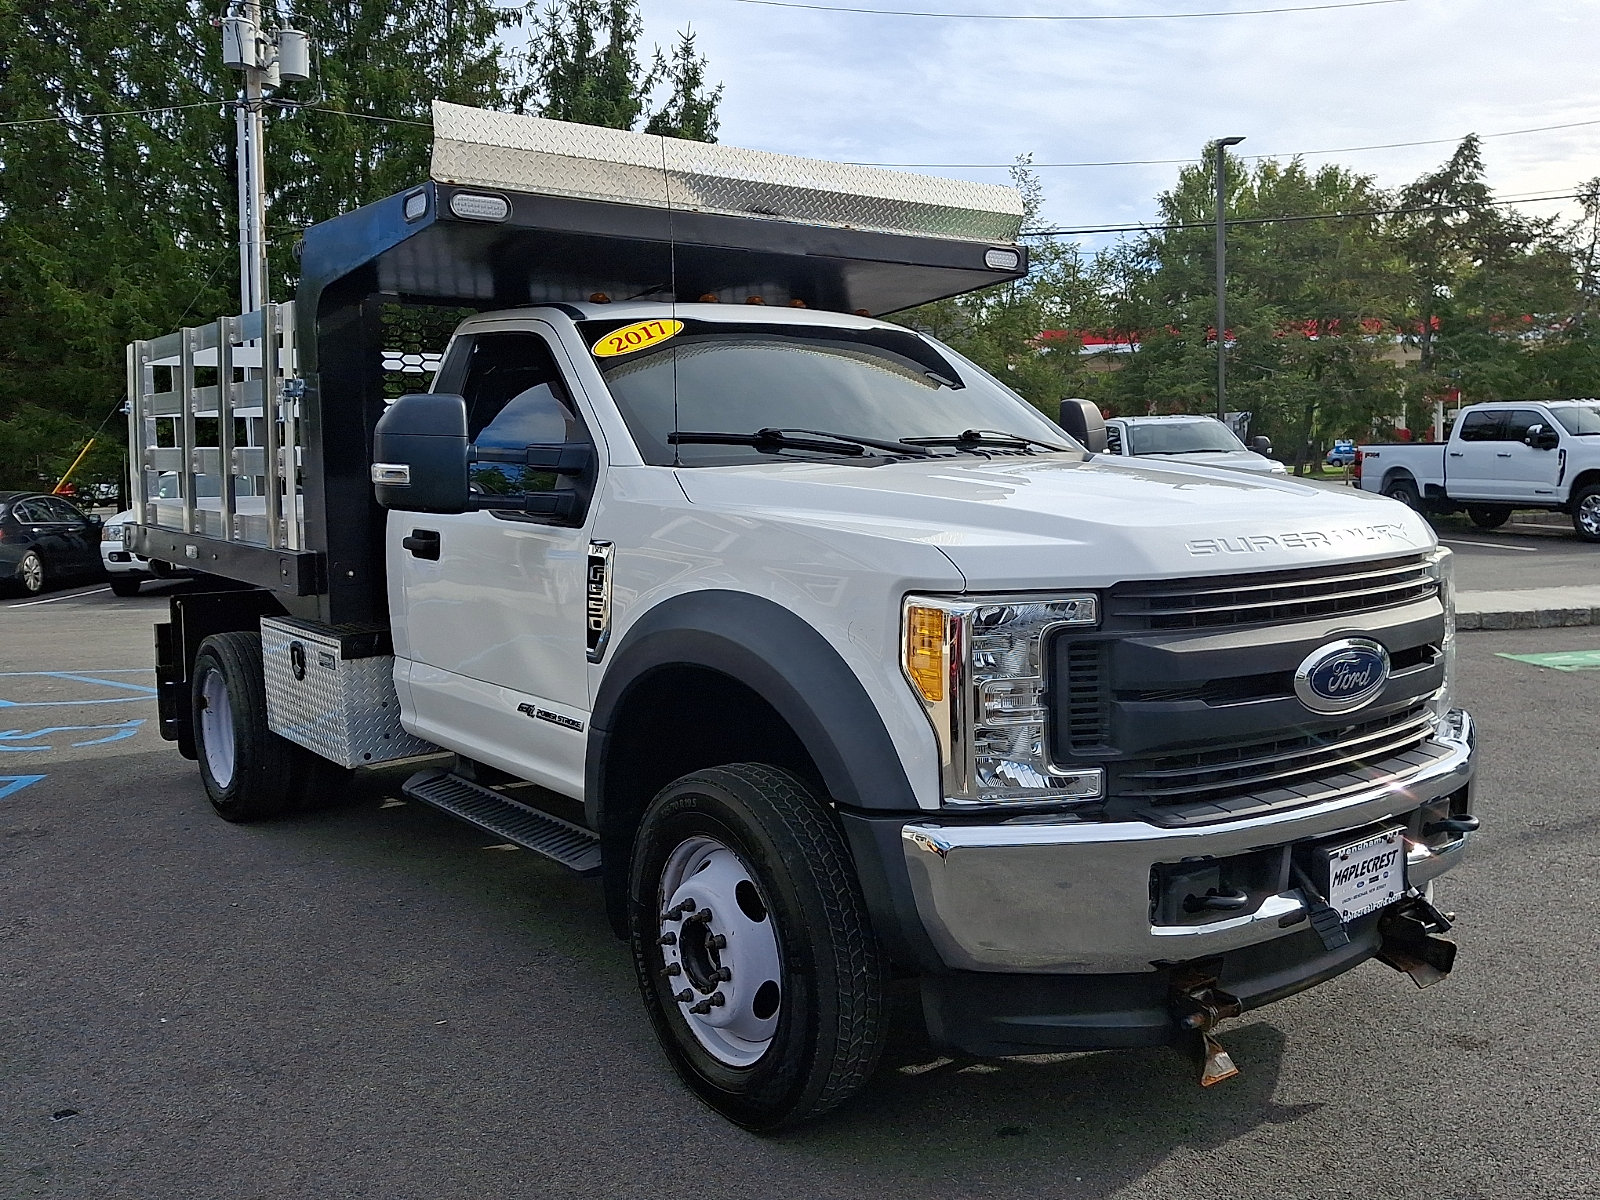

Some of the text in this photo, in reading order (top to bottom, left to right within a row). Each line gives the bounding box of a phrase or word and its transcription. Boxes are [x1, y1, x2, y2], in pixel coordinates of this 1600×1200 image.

[609, 321, 666, 352] 2017
[1185, 531, 1332, 557] SUPER
[1327, 657, 1372, 693] Ford
[536, 708, 558, 721] POWER
[557, 715, 582, 729] STROKE
[1332, 849, 1398, 887] MAPLECREST
[1340, 892, 1402, 923] aplecrestFord.com
